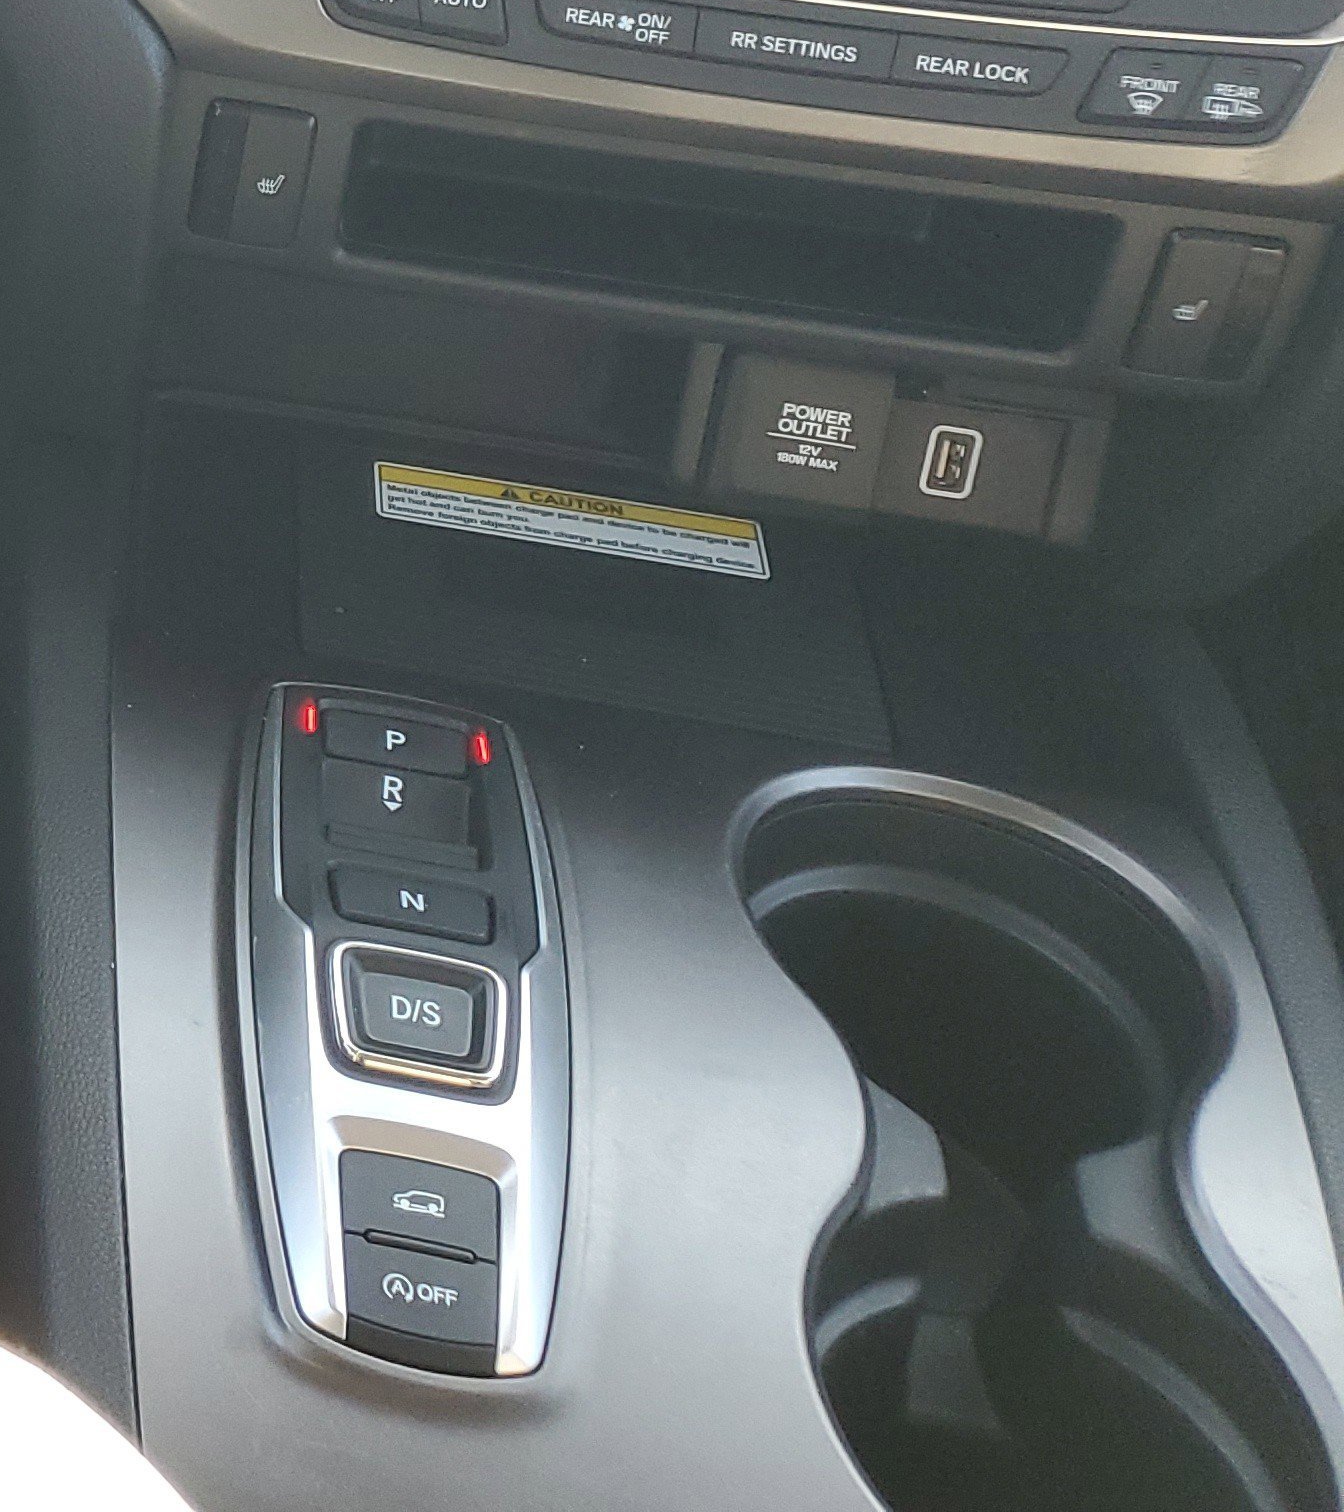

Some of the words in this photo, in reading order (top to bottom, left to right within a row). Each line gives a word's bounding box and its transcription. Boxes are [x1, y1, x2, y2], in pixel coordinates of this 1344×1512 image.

[565, 8, 616, 30] REAR
[637, 13, 672, 30] ON/
[635, 27, 670, 45] OFF
[731, 32, 759, 50] RR
[762, 34, 859, 63] SETTINGS
[915, 54, 969, 78] REAR
[972, 59, 1030, 84] LOCK
[1120, 75, 1180, 94] FRONT
[1213, 83, 1261, 101] REAR
[782, 402, 853, 427] POWER
[777, 418, 853, 443] OUTLET
[798, 443, 823, 457] 12V
[809, 456, 839, 471] MAX
[529, 490, 624, 516] CAUTION
[385, 729, 407, 751] P
[382, 774, 404, 802] R
[399, 889, 425, 913] N
[390, 994, 442, 1027] D/S
[416, 1283, 459, 1307] OFF
